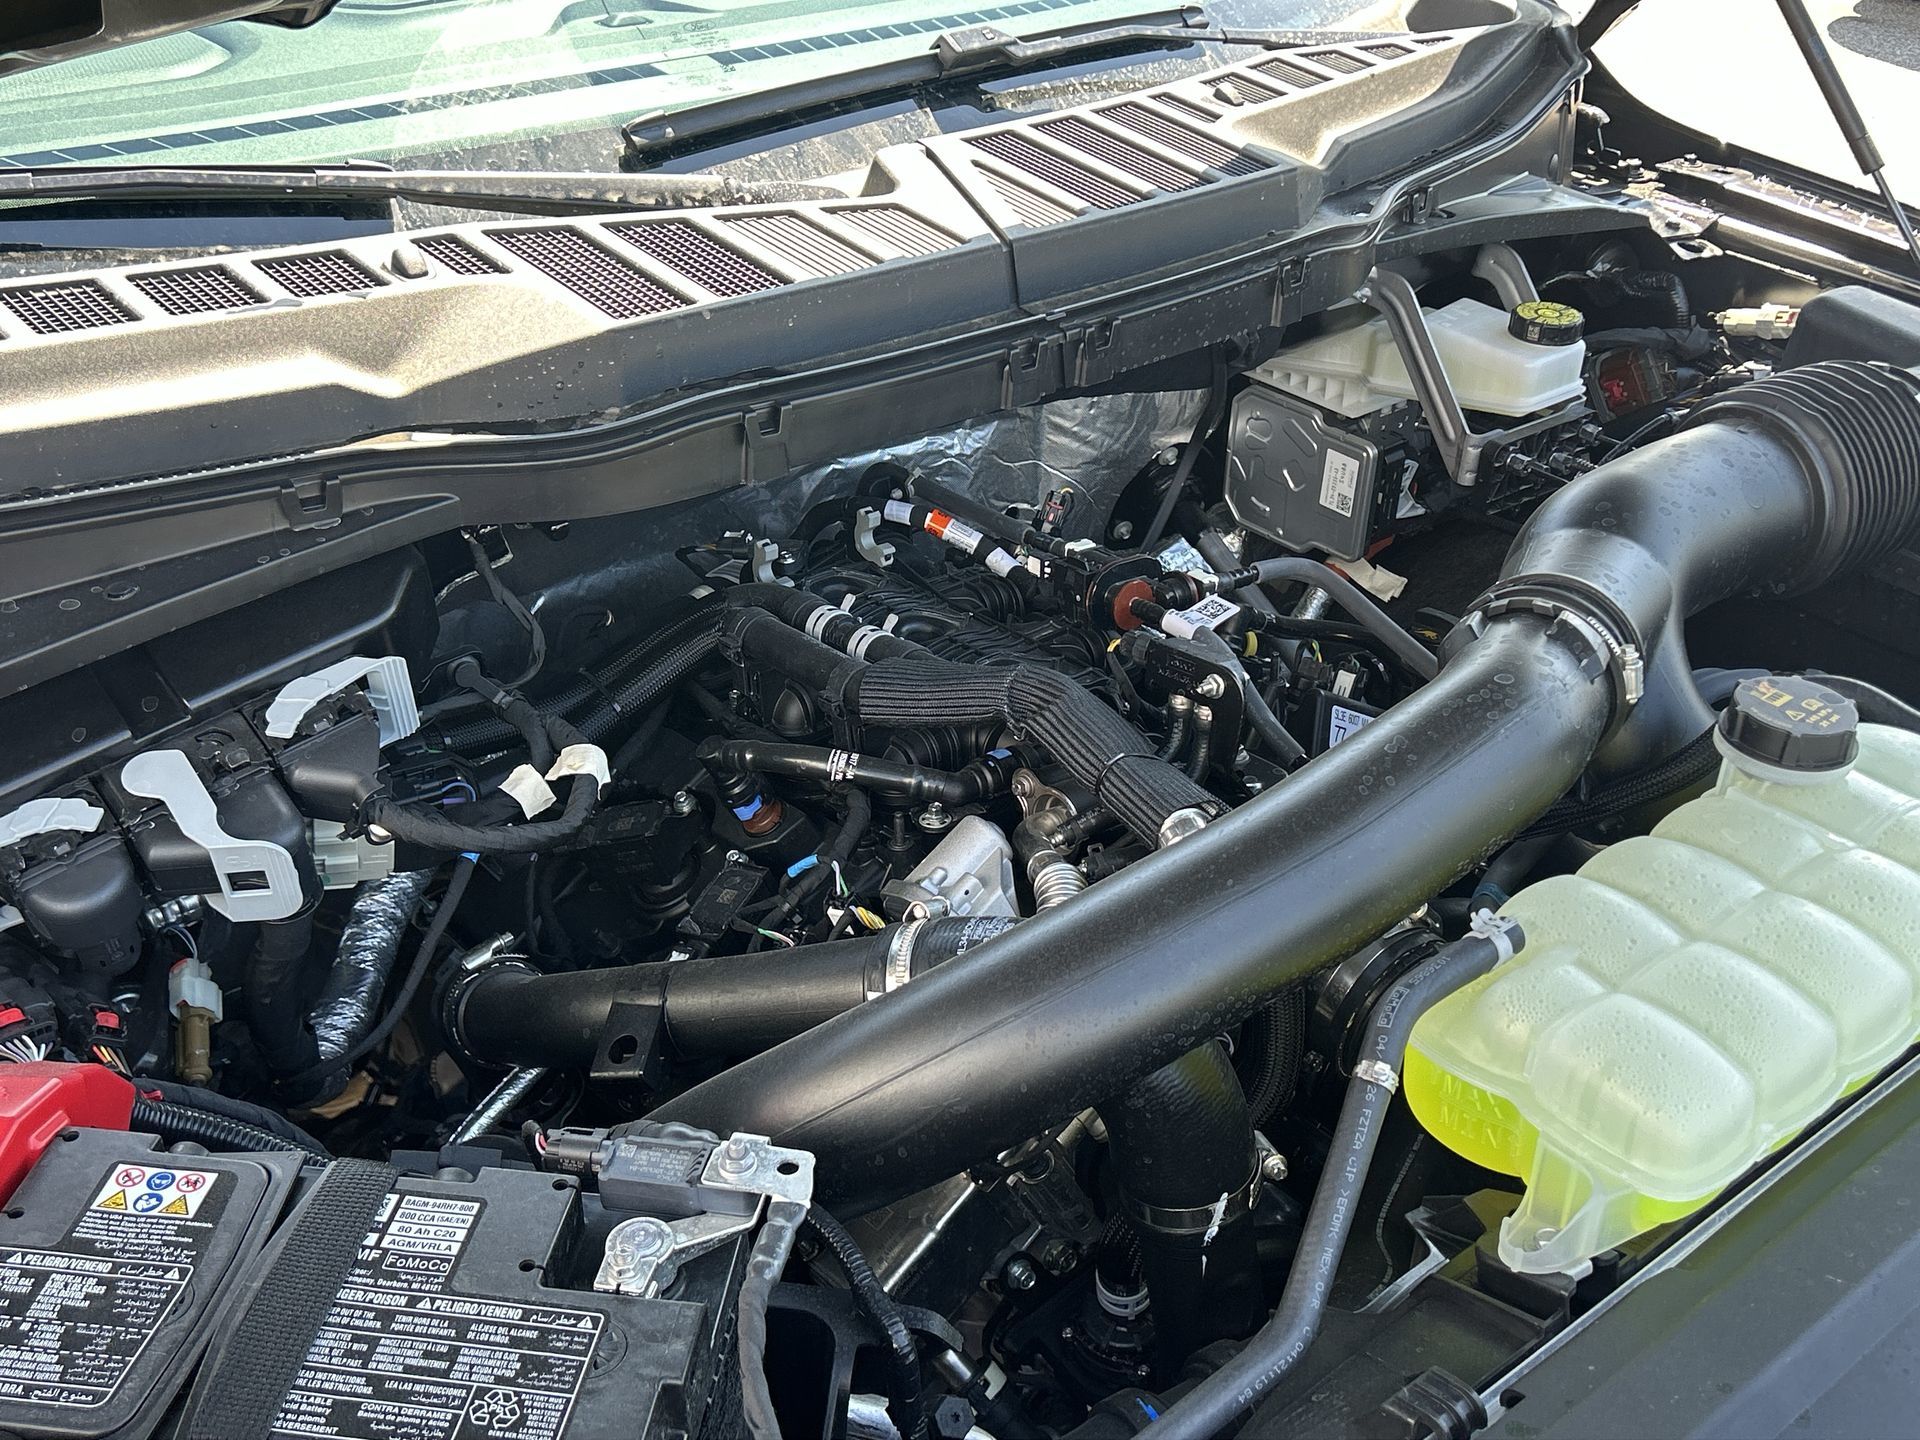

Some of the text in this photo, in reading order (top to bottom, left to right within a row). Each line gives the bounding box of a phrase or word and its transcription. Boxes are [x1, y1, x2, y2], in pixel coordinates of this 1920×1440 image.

[1440, 1104, 1500, 1149] MIN
[399, 1211, 470, 1225] 800 CCA (SAE/EN)
[413, 1227, 431, 1236] Ah
[433, 1229, 457, 1238] C20
[387, 1238, 452, 1252] AGM/VRLA
[23, 1254, 112, 1272] PELIGRO/VENENO
[385, 1254, 450, 1272] FoMoCo
[1320, 1248, 1334, 1274] MEX
[50, 1273, 98, 1286] PROTEJA LOS
[40, 1287, 86, 1299] EXPLOSIVOS
[67, 1282, 82, 1291] LOS
[82, 1284, 107, 1294] GASES
[35, 1294, 90, 1307] PUEDEN CAUSAR
[340, 1308, 376, 1319] OUT OF THE
[432, 1299, 523, 1320] PELIGRO/VENENO
[19, 1321, 32, 1331] NO
[342, 1317, 350, 1326] OF
[440, 1319, 449, 1328] LA
[414, 1324, 428, 1333] DES
[498, 1326, 510, 1335] DEL
[509, 1328, 538, 1339] ALCANCE
[32, 1331, 60, 1340] FLAMAS
[336, 1332, 353, 1341] EYES
[467, 1331, 476, 1339] DE
[475, 1332, 489, 1341] LOS
[28, 1339, 61, 1349] CIGARROS
[352, 1342, 369, 1352] WITH
[331, 1348, 345, 1356] GET
[491, 1350, 502, 1359] LOS
[502, 1352, 519, 1361] OJOS
[331, 1356, 347, 1365] HELP
[367, 1361, 379, 1369] UN
[508, 1361, 521, 1370] CON
[449, 1370, 462, 1379] CON
[462, 1372, 470, 1380] EL
[472, 1365, 492, 1374] ACUDA
[295, 1377, 307, 1387] IRE
[307, 1379, 322, 1388] LES
[385, 1380, 398, 1389] LEA
[398, 1381, 412, 1390] LAS
[521, 1393, 567, 1404] BATTERY MUST
[299, 1403, 332, 1415] Battery
[360, 1402, 453, 1420] CONTRA DERRAMES
[298, 1414, 326, 1424] plomb
[385, 1413, 396, 1421] de
